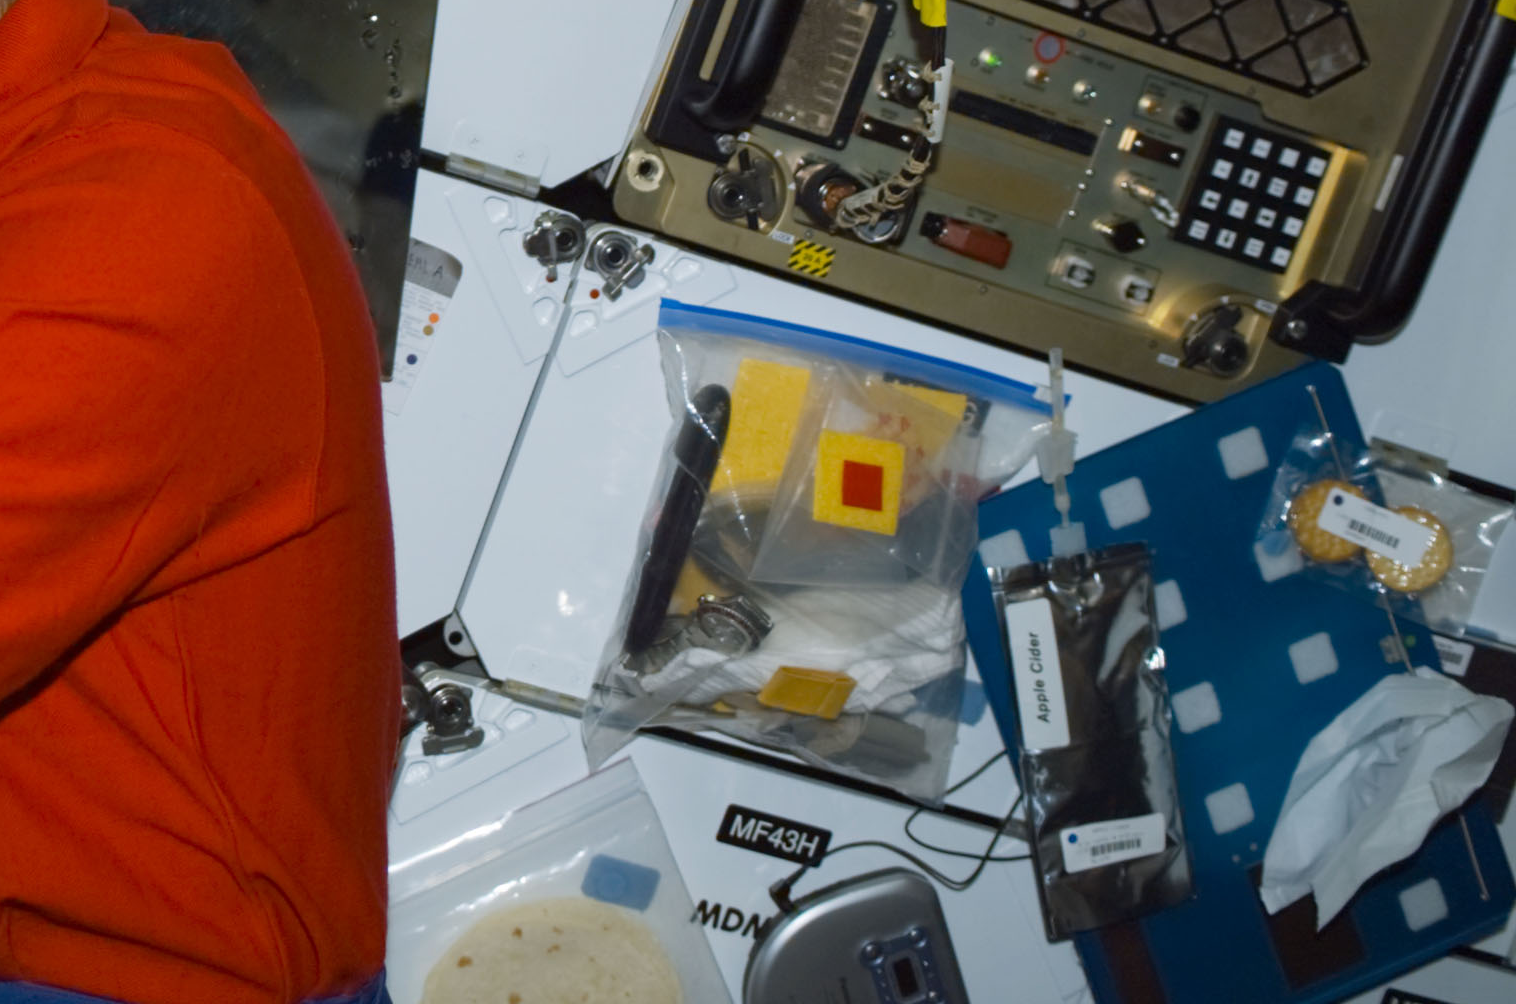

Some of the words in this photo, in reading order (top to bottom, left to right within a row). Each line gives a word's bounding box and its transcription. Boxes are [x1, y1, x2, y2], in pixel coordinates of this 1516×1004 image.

[1029, 632, 1044, 674] Cider
[1034, 679, 1052, 724] Apple
[729, 814, 819, 858] MF43H
